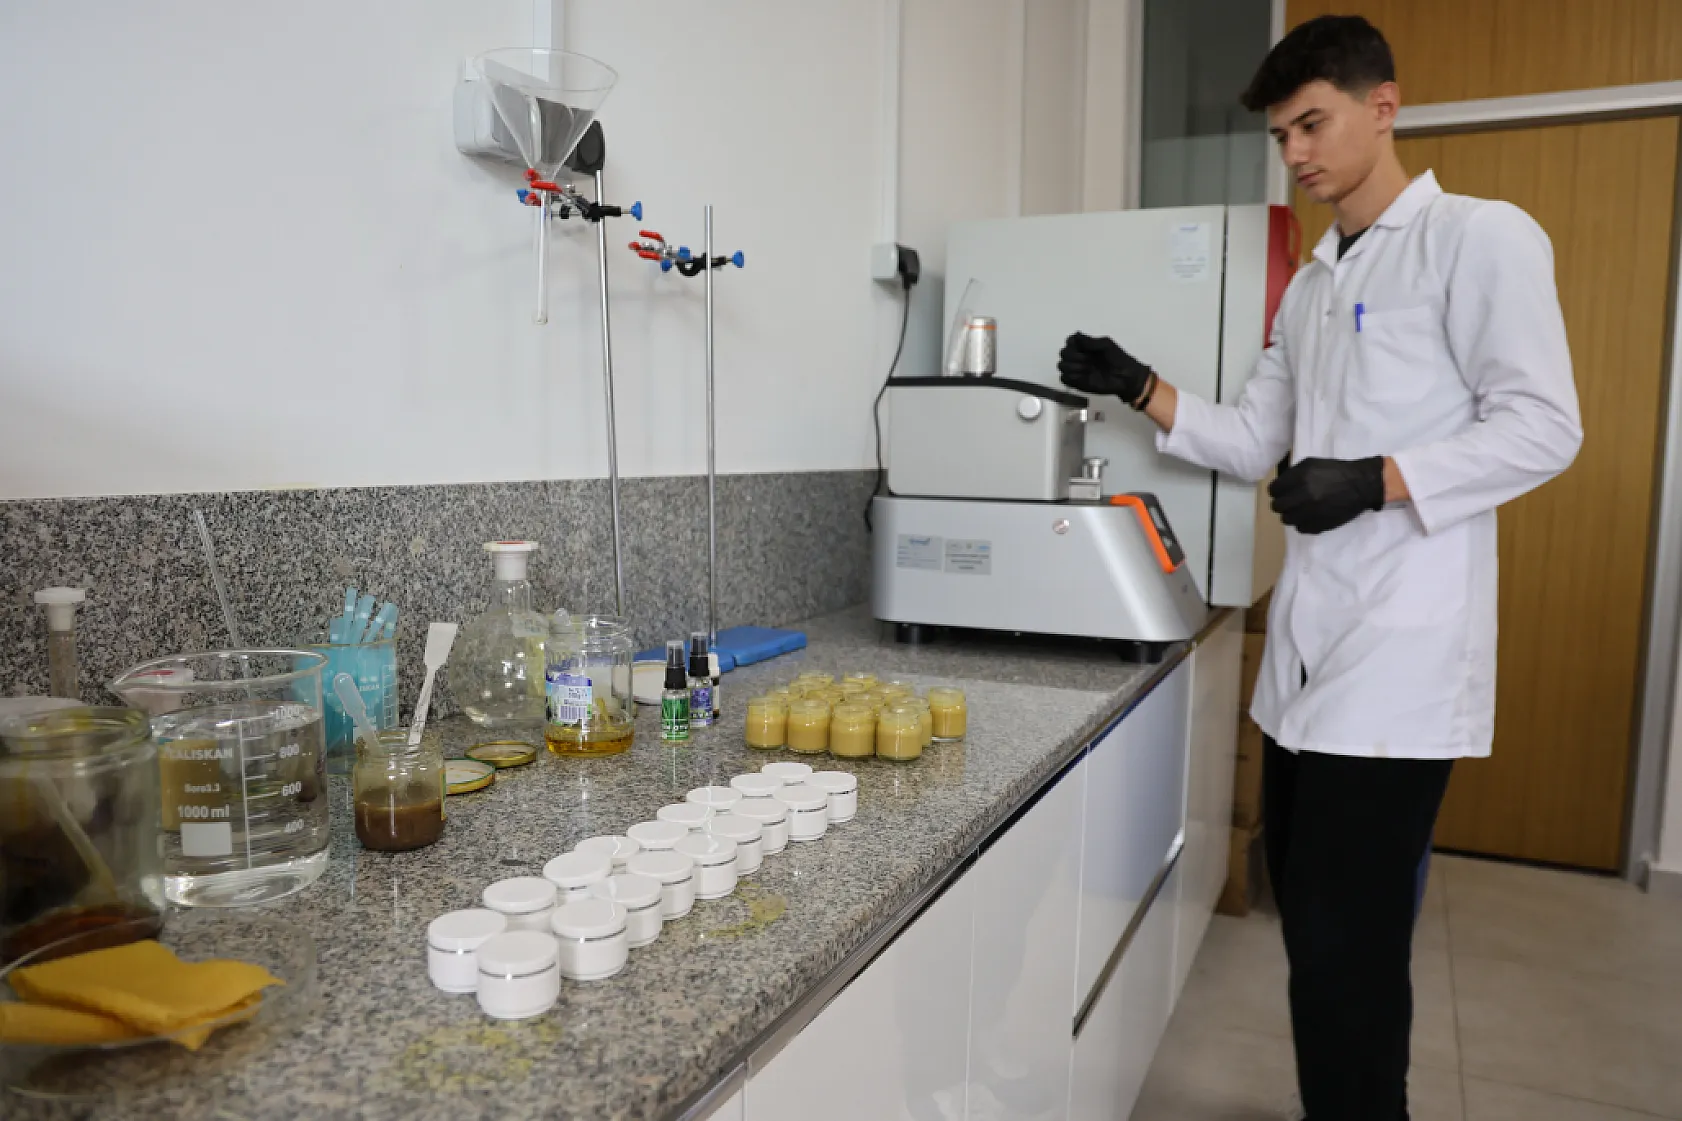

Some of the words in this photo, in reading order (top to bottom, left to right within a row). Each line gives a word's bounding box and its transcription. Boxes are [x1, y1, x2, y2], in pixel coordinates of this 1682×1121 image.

[282, 780, 302, 796] 600
[178, 805, 208, 819] 1000
[211, 803, 230, 817] ml
